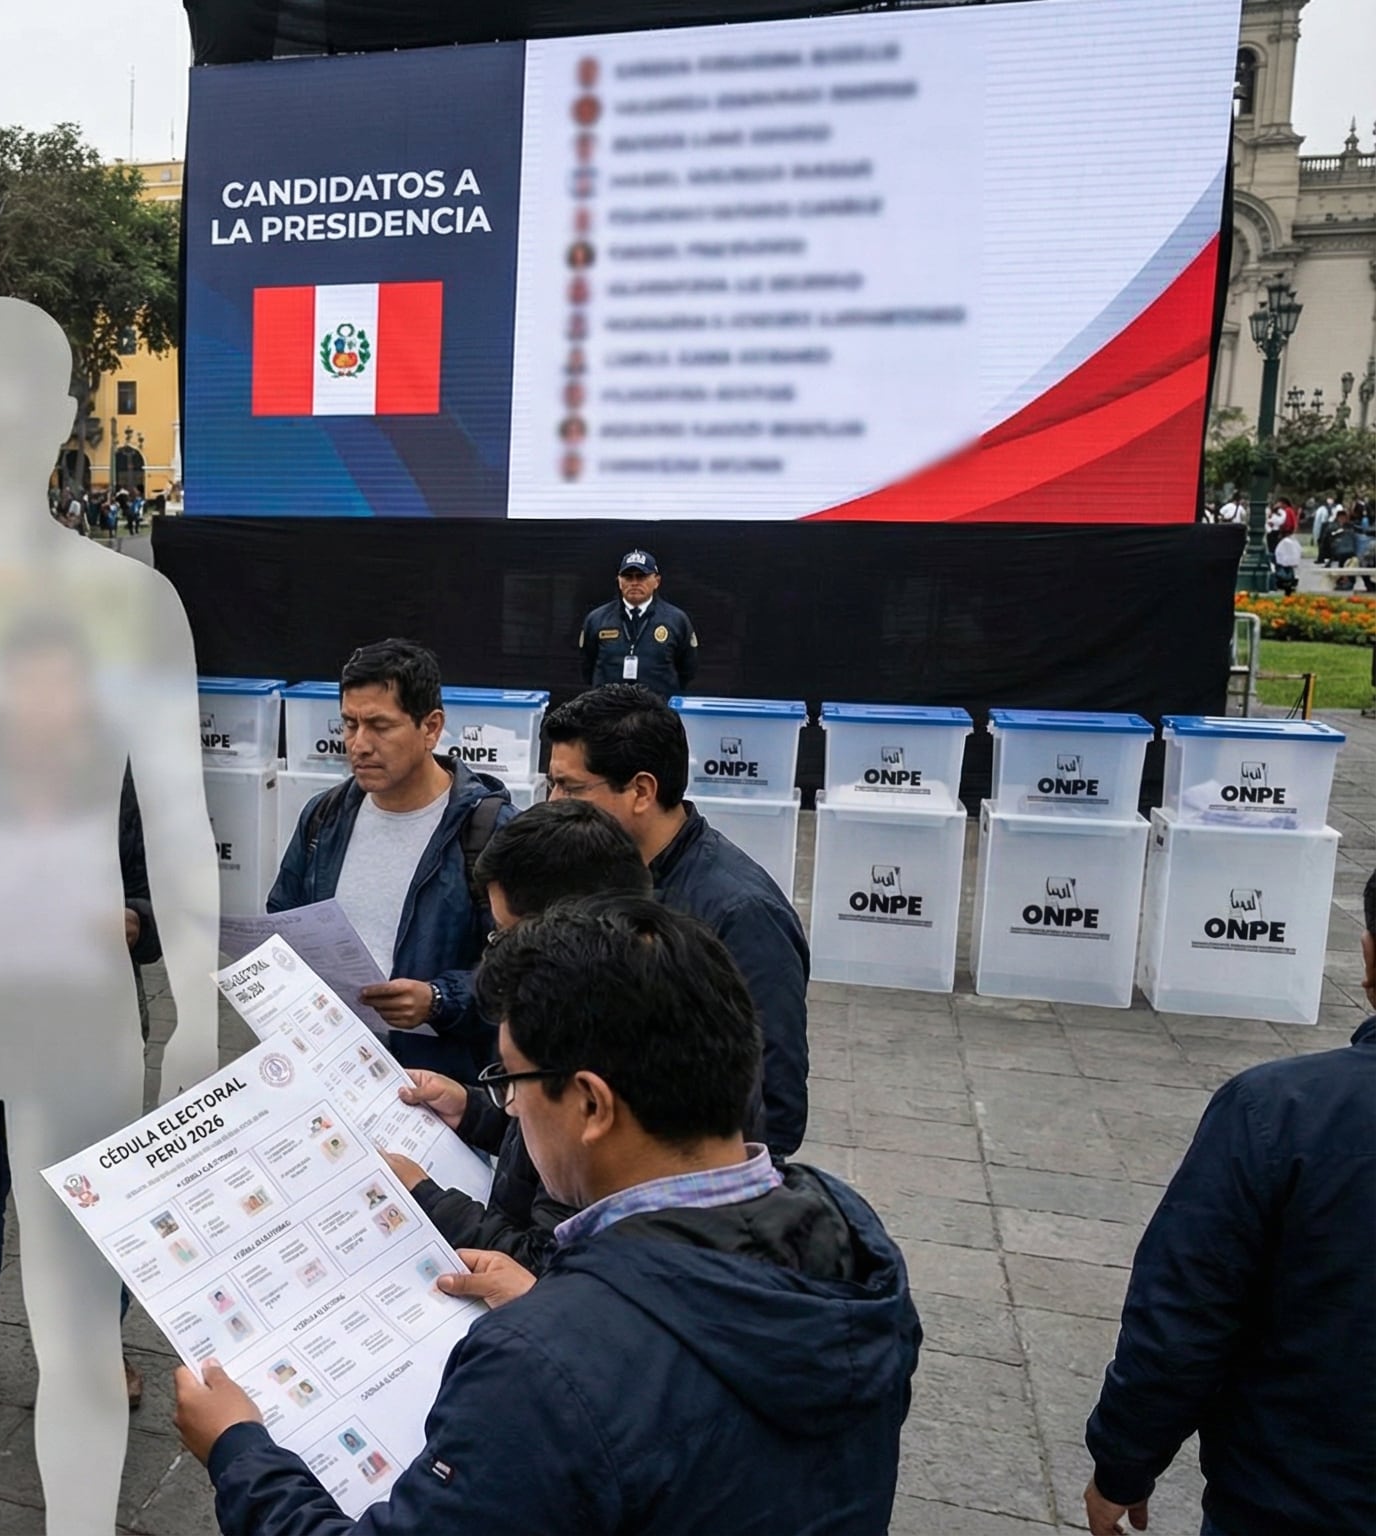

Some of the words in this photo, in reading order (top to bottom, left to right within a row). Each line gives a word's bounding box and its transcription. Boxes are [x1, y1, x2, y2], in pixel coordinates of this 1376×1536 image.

[222, 169, 446, 209] CANDIDATOS
[453, 168, 482, 197] A
[211, 218, 253, 245] LA
[262, 206, 492, 243] PRESIDENCIA
[201, 734, 231, 749] NPE
[316, 739, 348, 754] ON
[448, 746, 498, 762] ONPE
[704, 760, 759, 778] ONPE
[864, 769, 922, 786] ONPE
[1038, 777, 1099, 796] ONPE
[1221, 785, 1286, 804] ONPE
[849, 892, 923, 916] ONPE
[1022, 905, 1099, 929] ONPE
[1204, 918, 1286, 942] ONPE
[99, 1130, 161, 1169] CÉDULA
[157, 1077, 248, 1136] ELECTORAL
[187, 1114, 225, 1144] 2026
